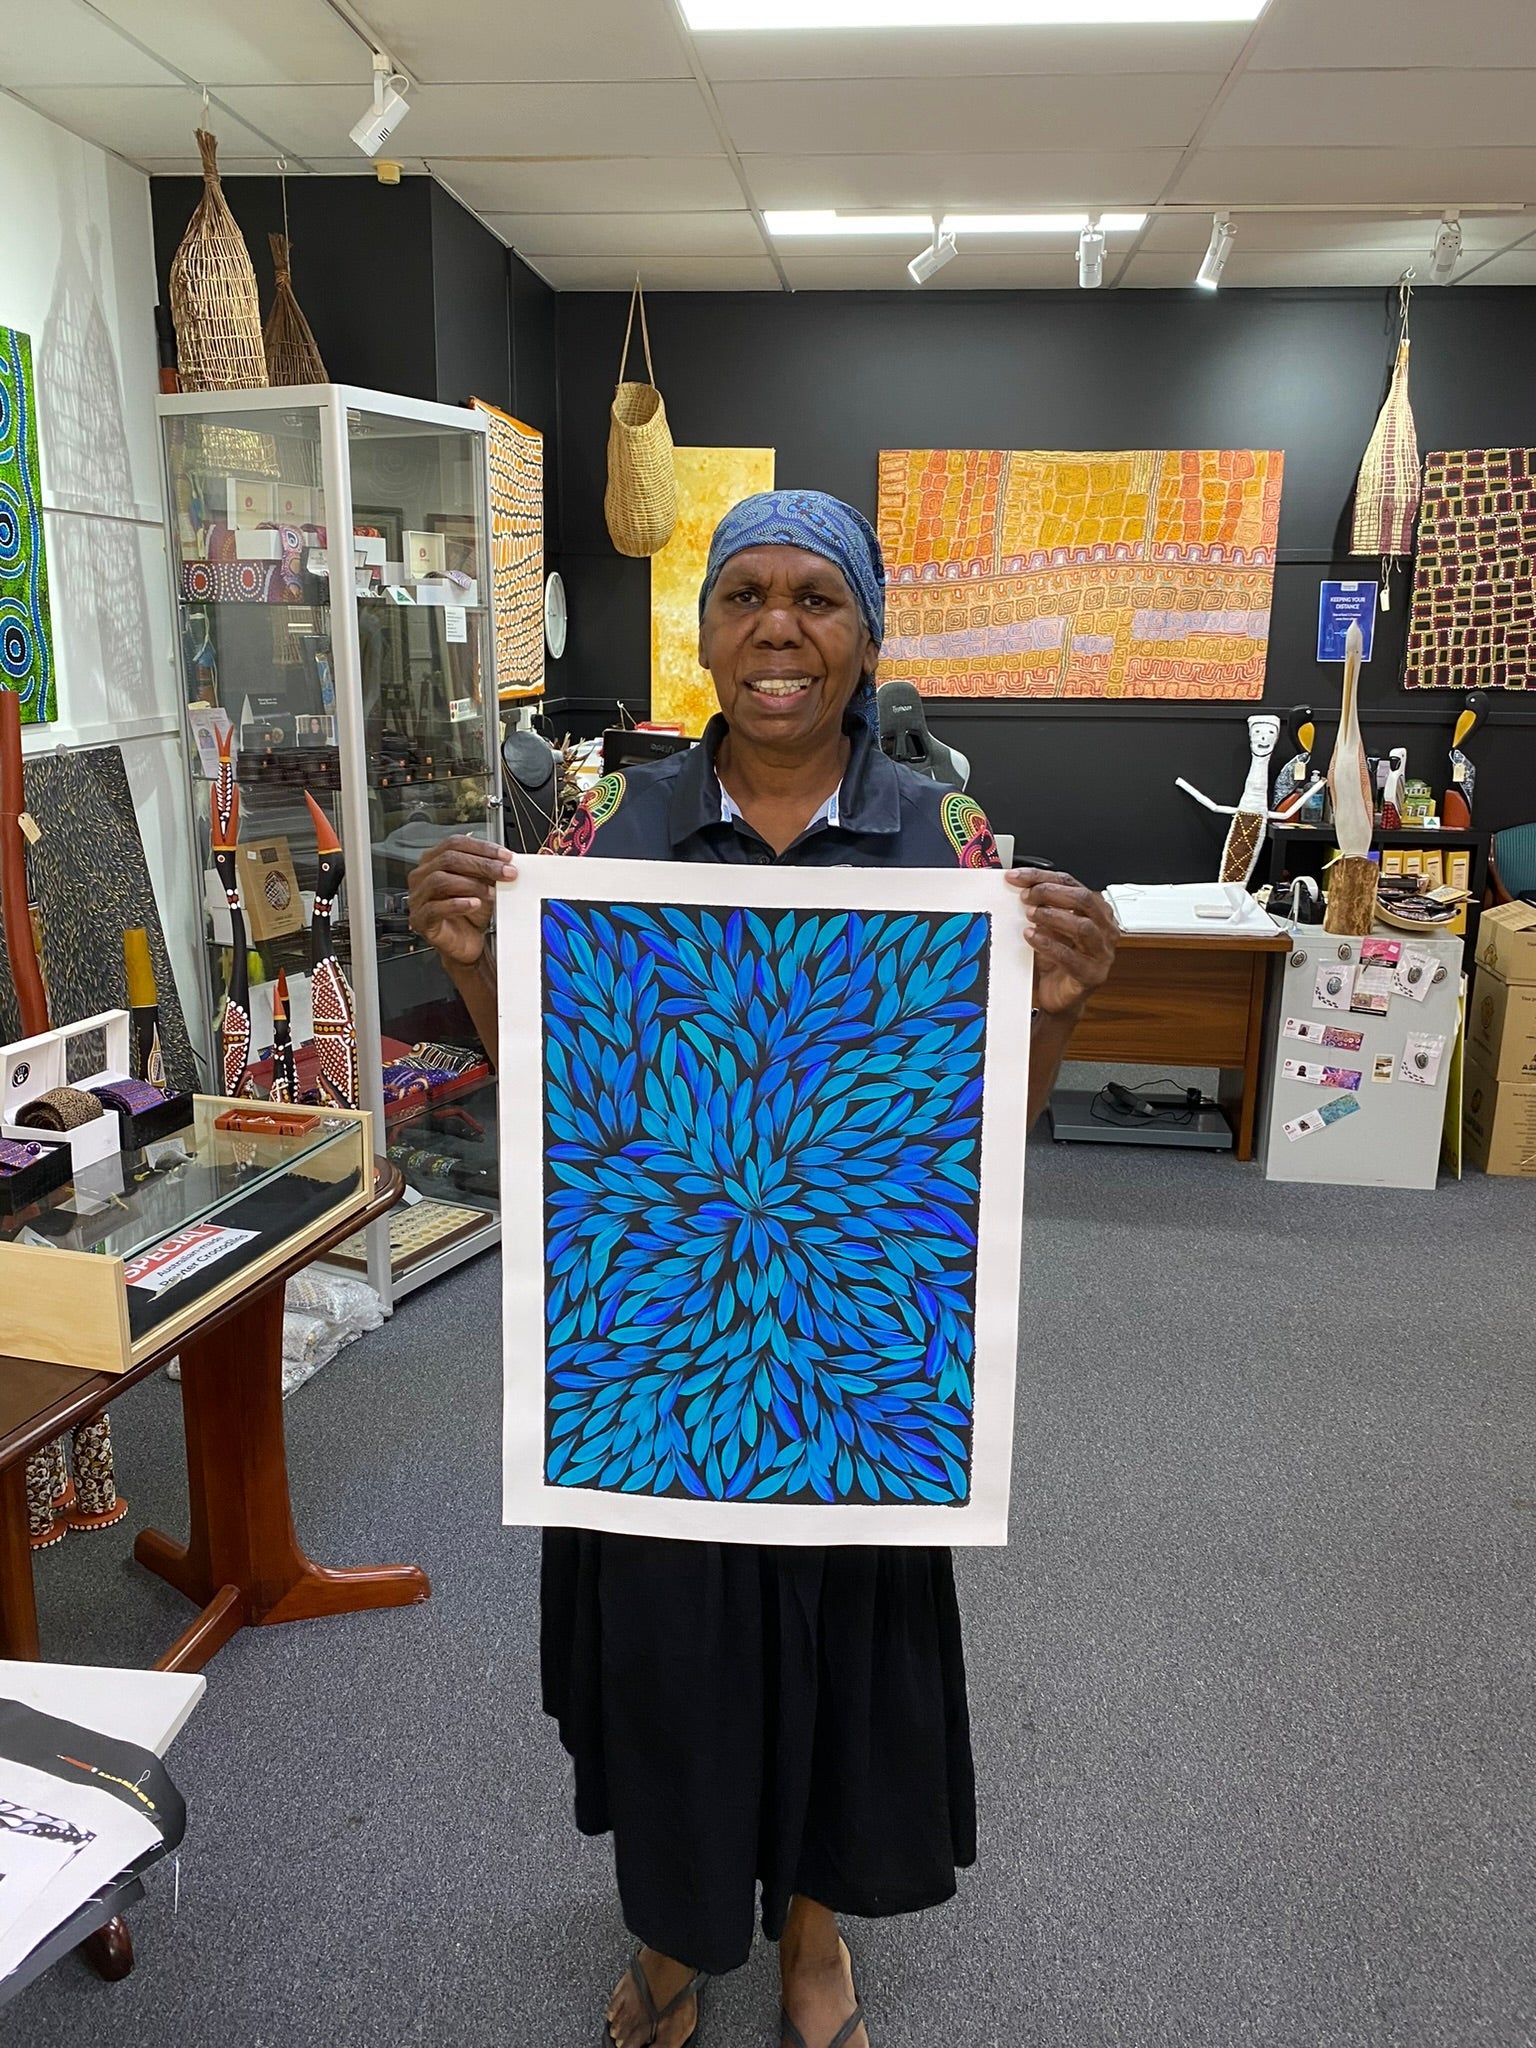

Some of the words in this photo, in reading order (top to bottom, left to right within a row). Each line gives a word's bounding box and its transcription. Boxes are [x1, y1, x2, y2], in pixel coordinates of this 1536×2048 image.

[124, 1229, 215, 1279] SPECIAL
[157, 1236, 225, 1277] Australian-made
[198, 1234, 249, 1262] Crocodiles
